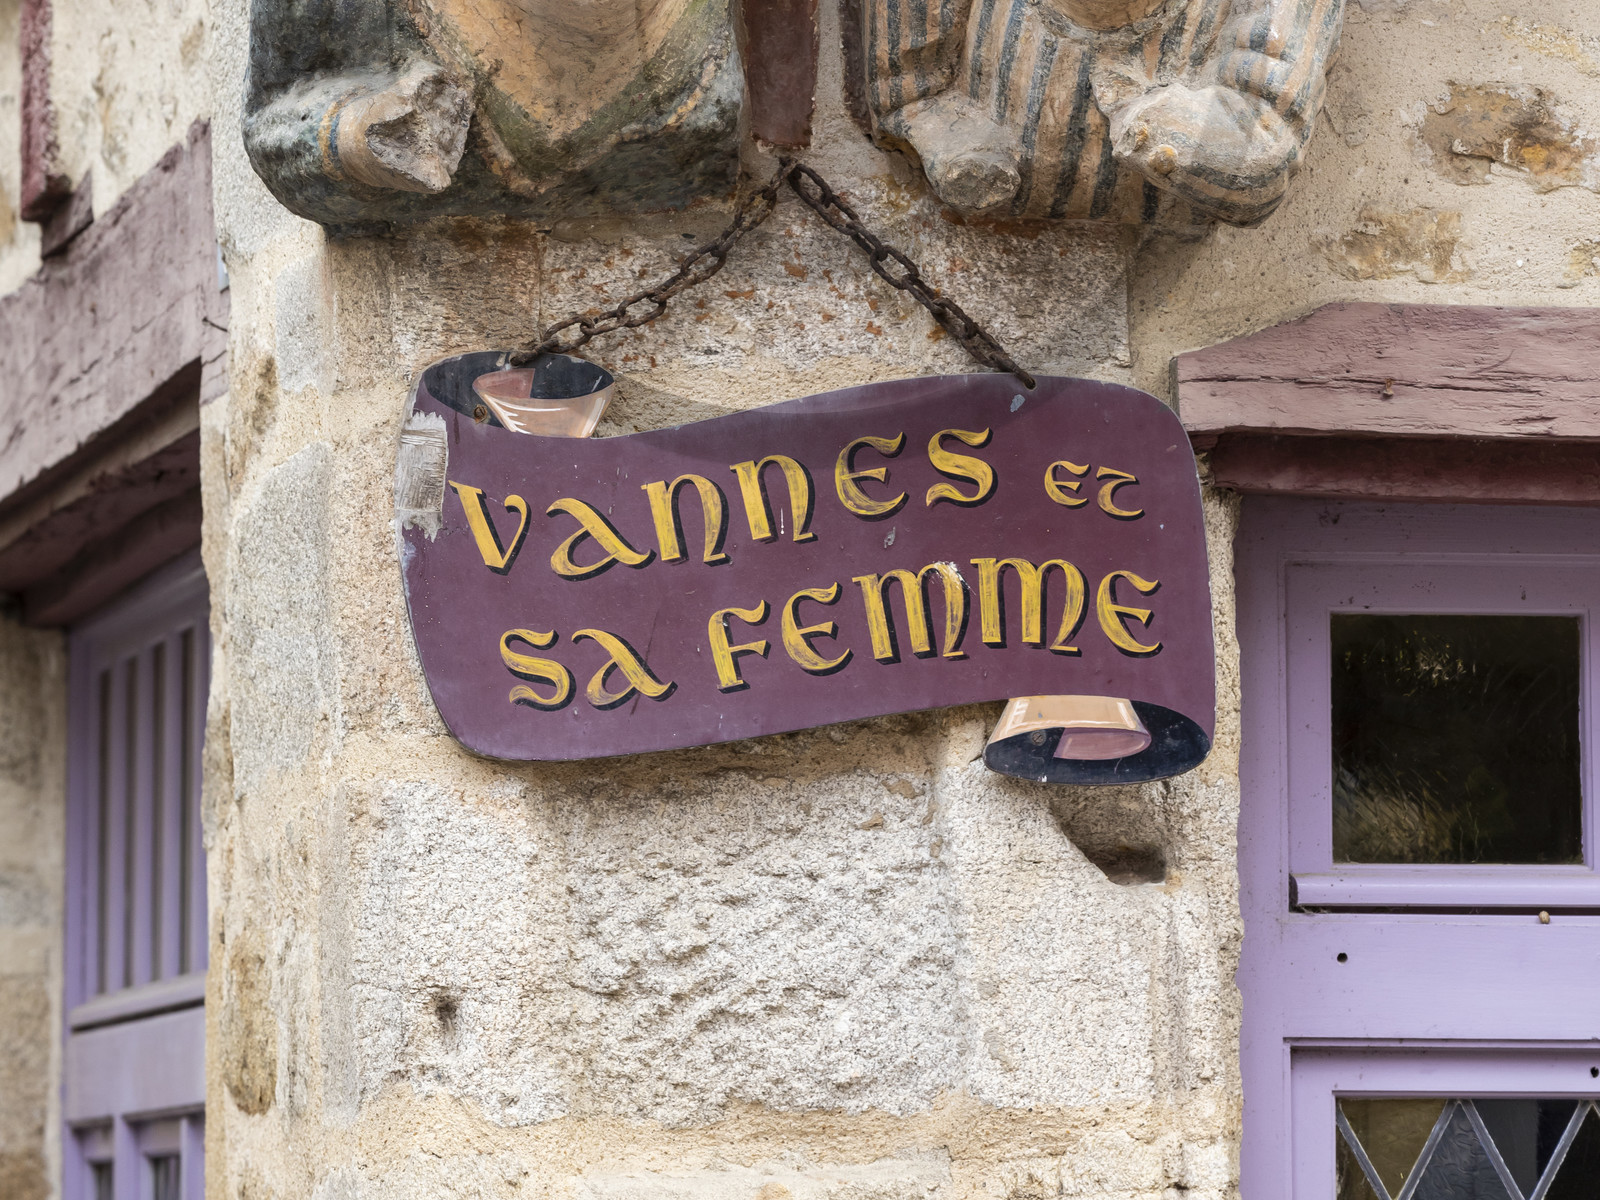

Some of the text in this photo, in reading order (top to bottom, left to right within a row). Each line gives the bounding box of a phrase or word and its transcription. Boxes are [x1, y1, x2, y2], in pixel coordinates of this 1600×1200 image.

[448, 426, 1146, 581] VANNES ET
[499, 556, 1166, 712] SA FEMME
